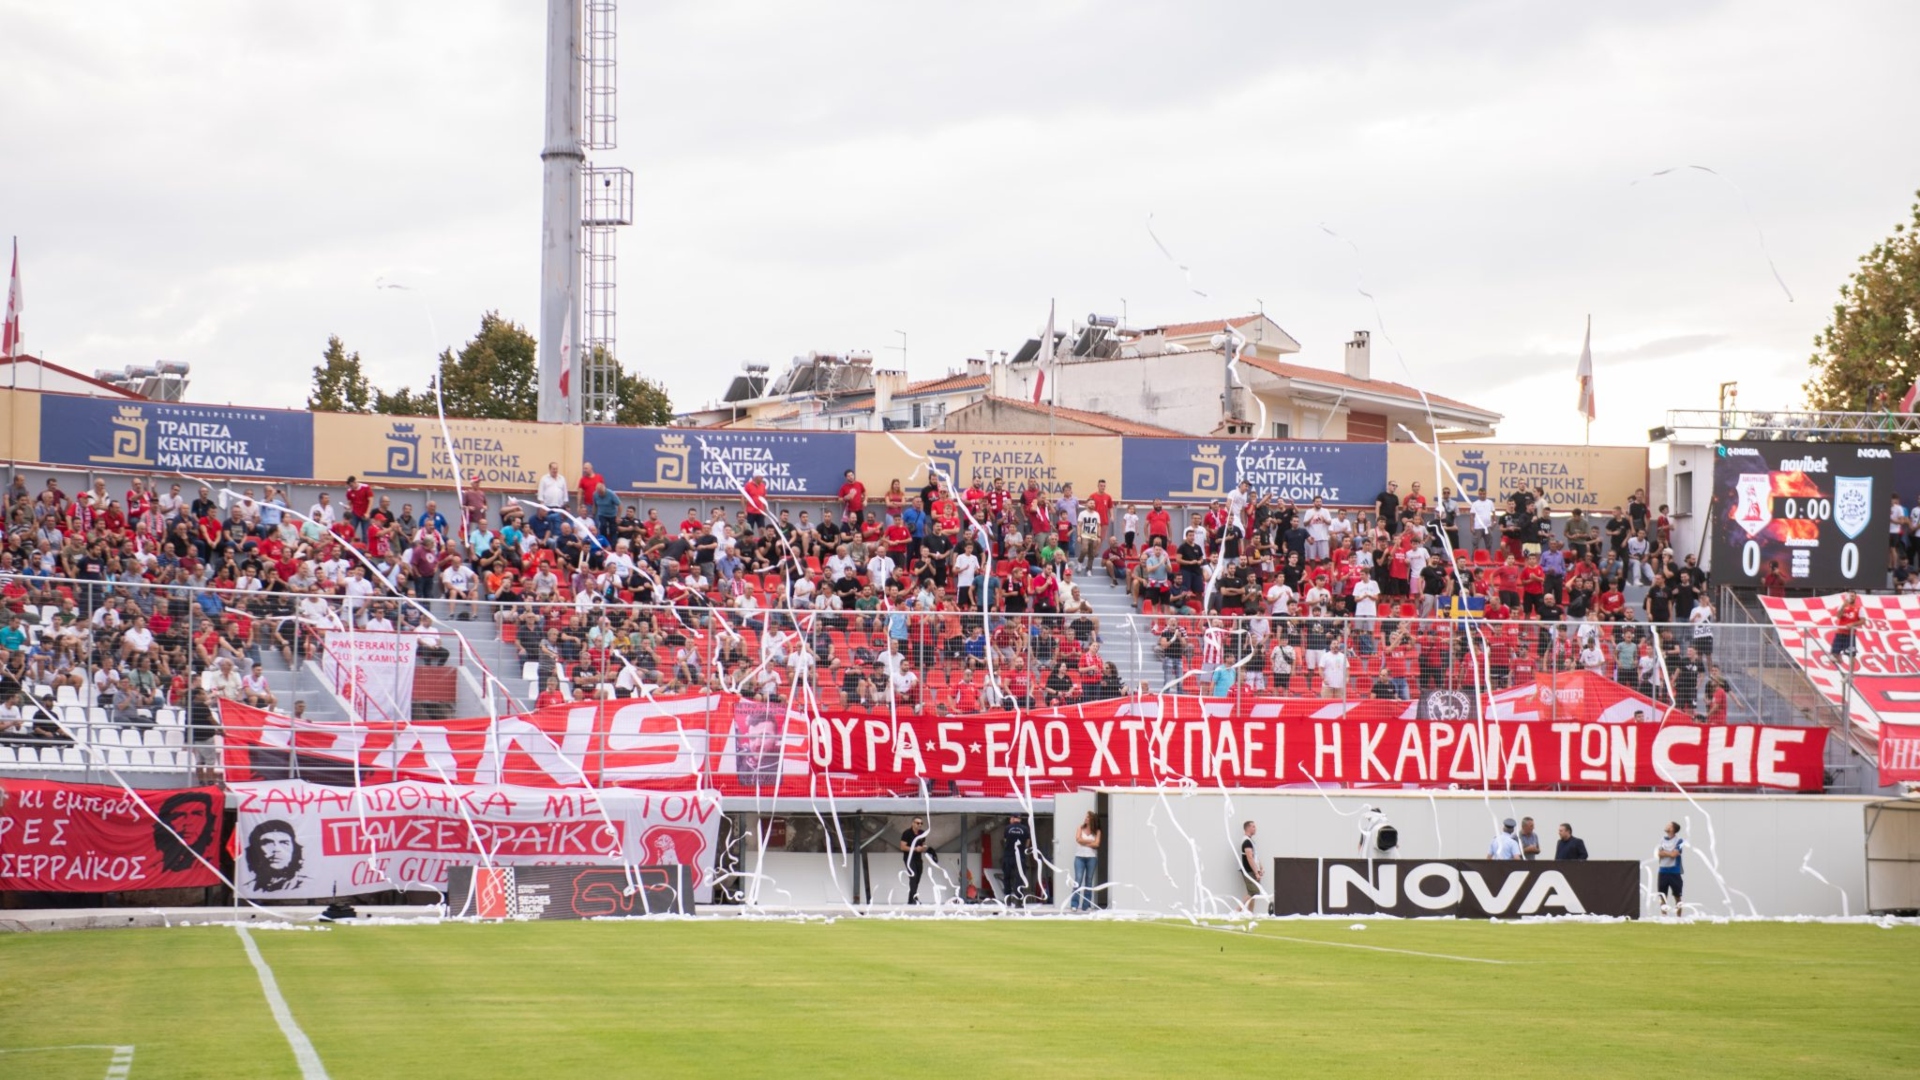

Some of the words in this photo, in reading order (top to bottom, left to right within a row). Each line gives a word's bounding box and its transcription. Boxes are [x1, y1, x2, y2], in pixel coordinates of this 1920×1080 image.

[157, 408, 266, 420] ΣΥΝΕΤΑΙΡΙΣΤΙΚΗ
[157, 420, 232, 438] ΤΡΑΠΕΖΑ
[158, 436, 249, 455] ΚΕΝΤΡΙΚΗΣ
[700, 446, 774, 461] ΤΡΑΠΕΖΑ
[1857, 448, 1892, 459] NOVA
[157, 452, 266, 472] ΜΑΚΕΔΟΝΙΑΣ
[972, 451, 1044, 464] ΤΡΑΠΕΖΑ
[1235, 457, 1307, 471] ΤΡΑΠΕΖΑ
[1780, 455, 1829, 473] novibet
[972, 466, 1057, 479] ΚΕΝΤΡΙΚΗΣ
[1499, 462, 1569, 475] ΤΡΑΠΕΖΑ
[700, 476, 808, 491] ΜΑΚΕΟΝΙΑΣ
[1742, 540, 1761, 577] 0
[1841, 542, 1860, 579] 0
[811, 716, 926, 774] ΘΥΡΑ
[941, 721, 964, 773] 5
[984, 722, 1074, 777] ΕΔΩ
[1083, 720, 1286, 779] ΧΤΥΠΑΕΙ
[1314, 722, 1343, 778] Η
[1360, 722, 1536, 783] ΚΑΡΔΙΑ
[1552, 722, 1638, 783] ΤΩΝ
[1652, 725, 1808, 788] CHE
[53, 789, 141, 822] εμπρός
[544, 792, 603, 818] ΜΕ
[633, 794, 717, 825] ΤΟΝ
[328, 818, 620, 855] ΠΑΝΣΕΡΡΑΪΚΟ
[1, 851, 147, 880] ΣΕΡΡΑΪΚΟΣ
[1328, 862, 1587, 914] NOVA
